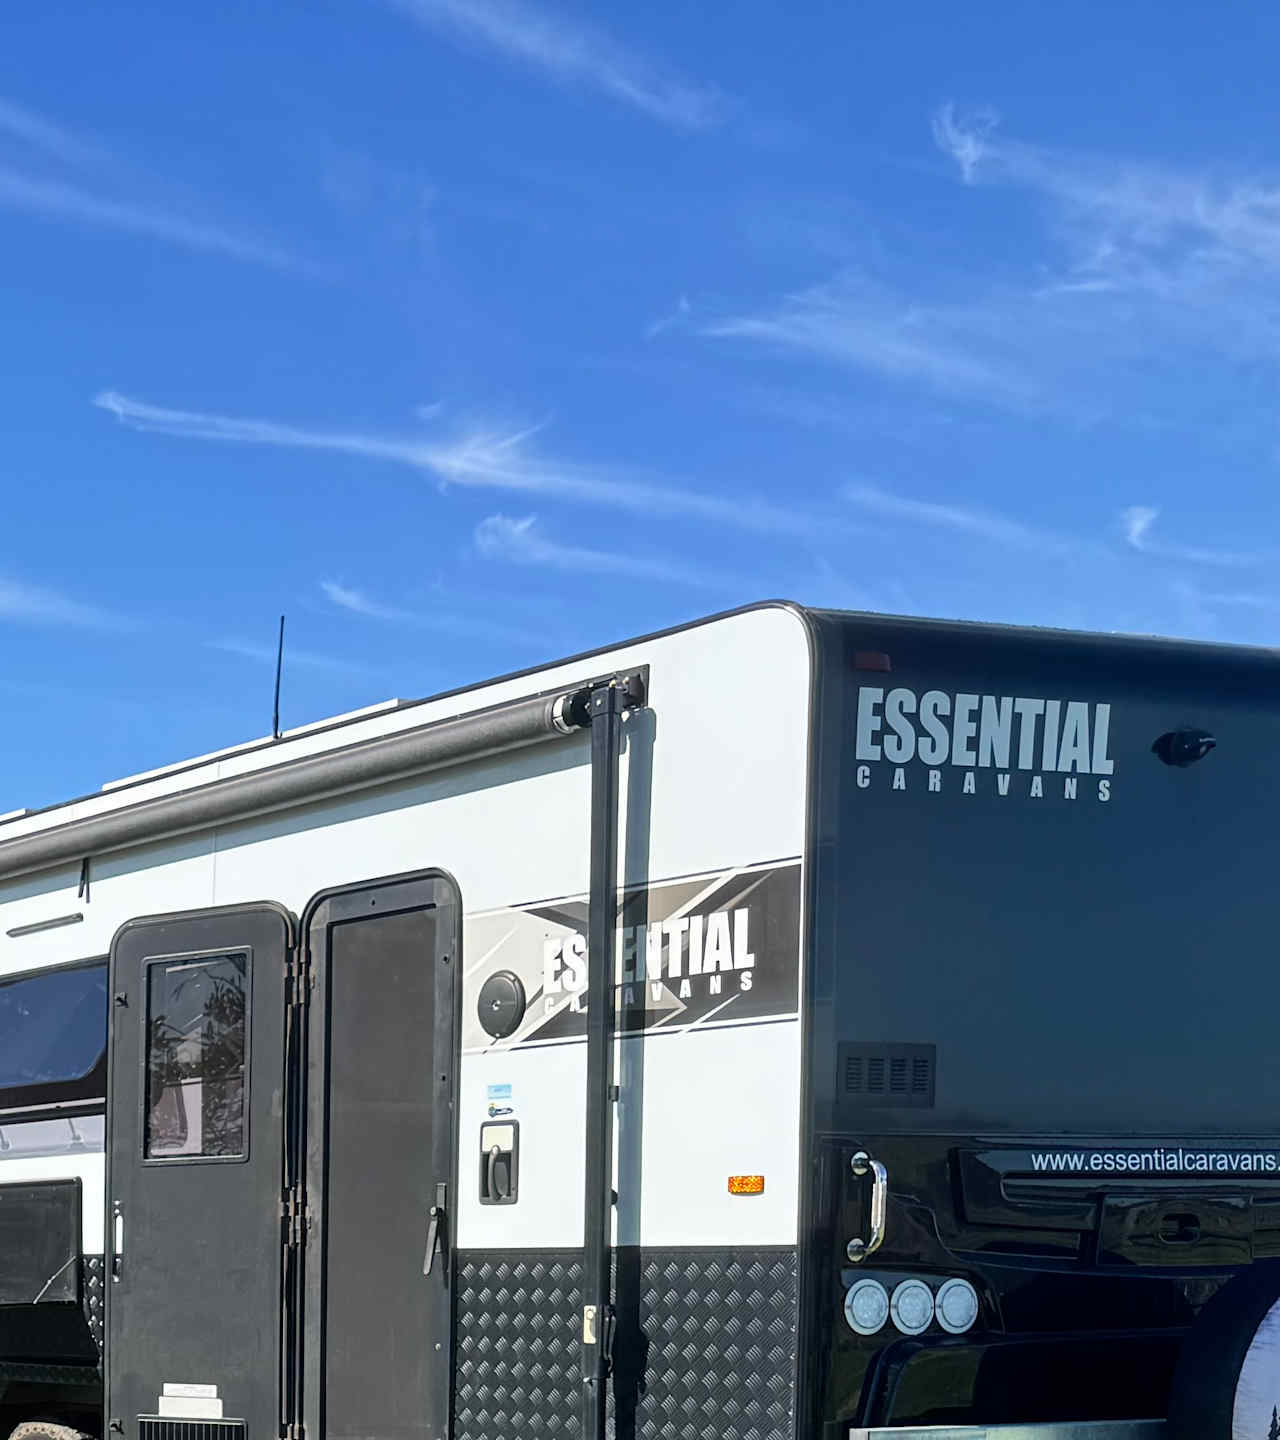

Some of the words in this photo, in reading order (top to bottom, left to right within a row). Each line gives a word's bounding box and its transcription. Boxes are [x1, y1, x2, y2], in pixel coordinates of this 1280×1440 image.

[855, 686, 1115, 776] ESSENTIAL
[856, 764, 1112, 802] CARAVANS
[543, 907, 755, 994] ESENTIAL
[544, 970, 753, 1015] CAAVANS
